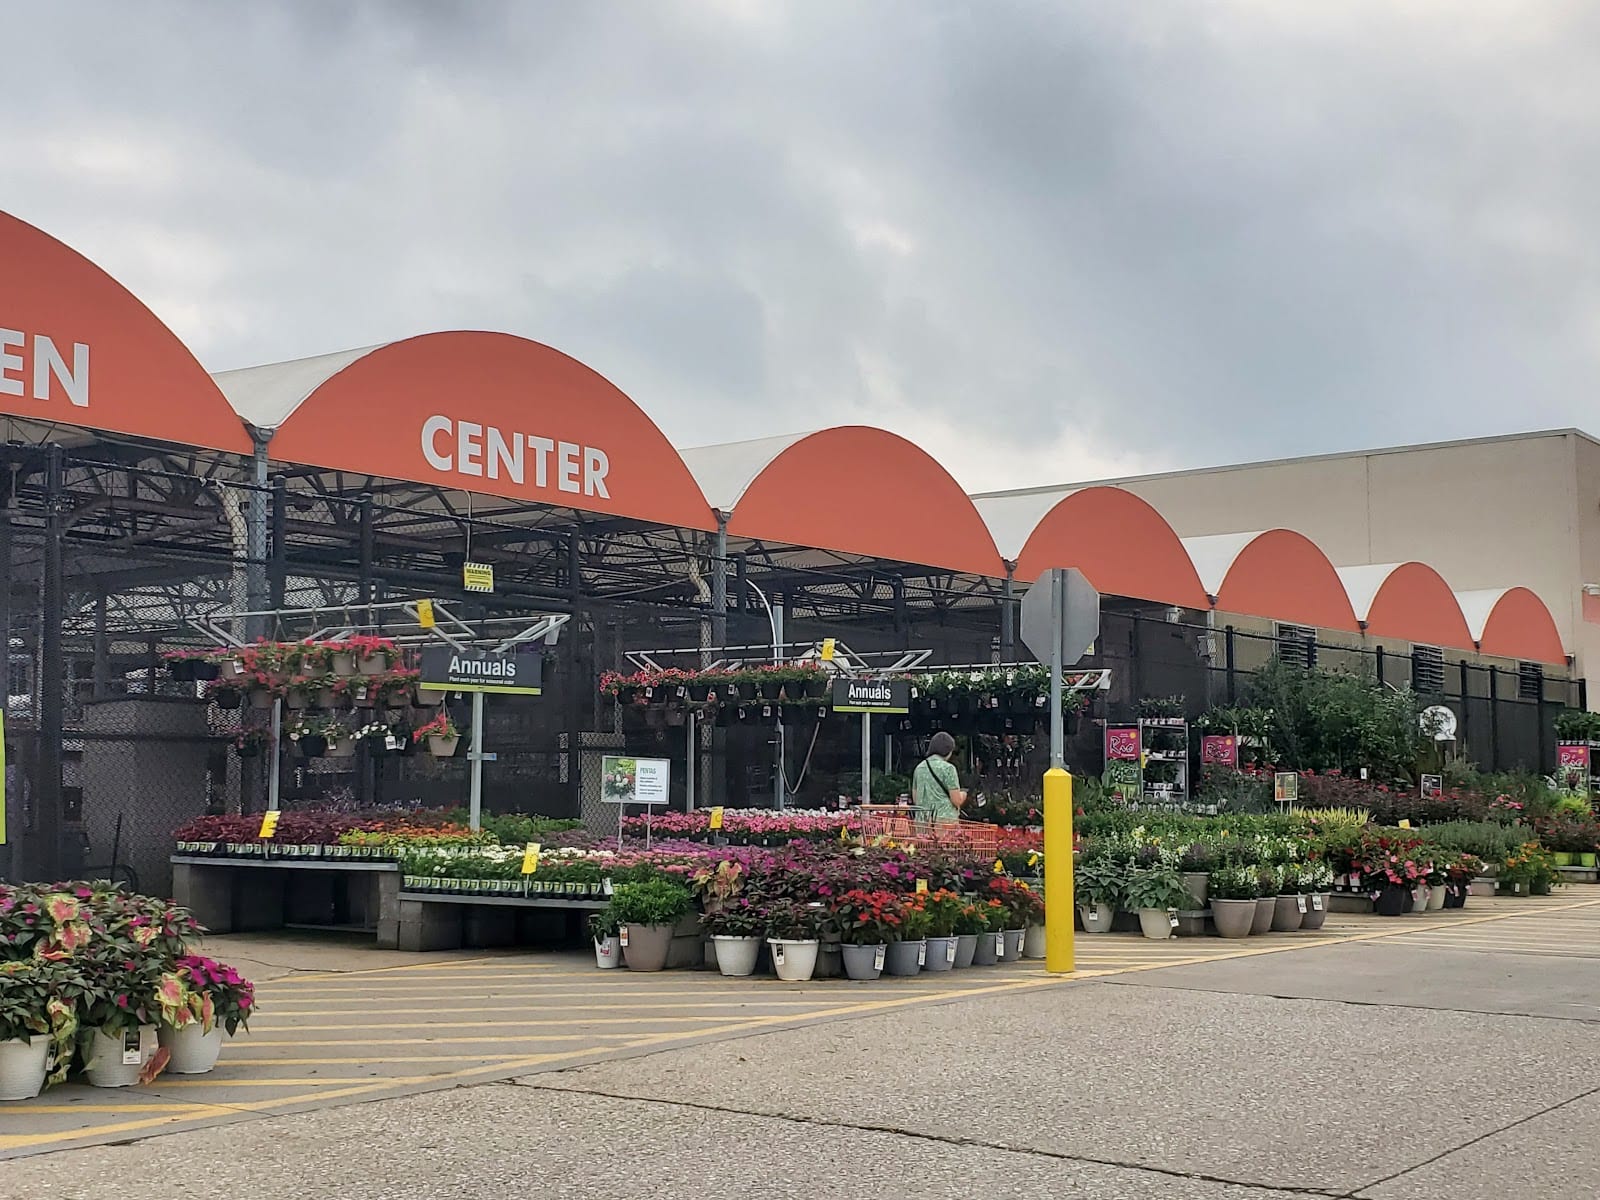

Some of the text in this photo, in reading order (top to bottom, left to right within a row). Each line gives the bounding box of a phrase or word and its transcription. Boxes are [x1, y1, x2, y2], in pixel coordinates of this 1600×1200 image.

[421, 415, 611, 499] CENTER
[448, 655, 516, 677] Annuals
[848, 683, 892, 700] Annuals
[1110, 736, 1135, 755] Rio
